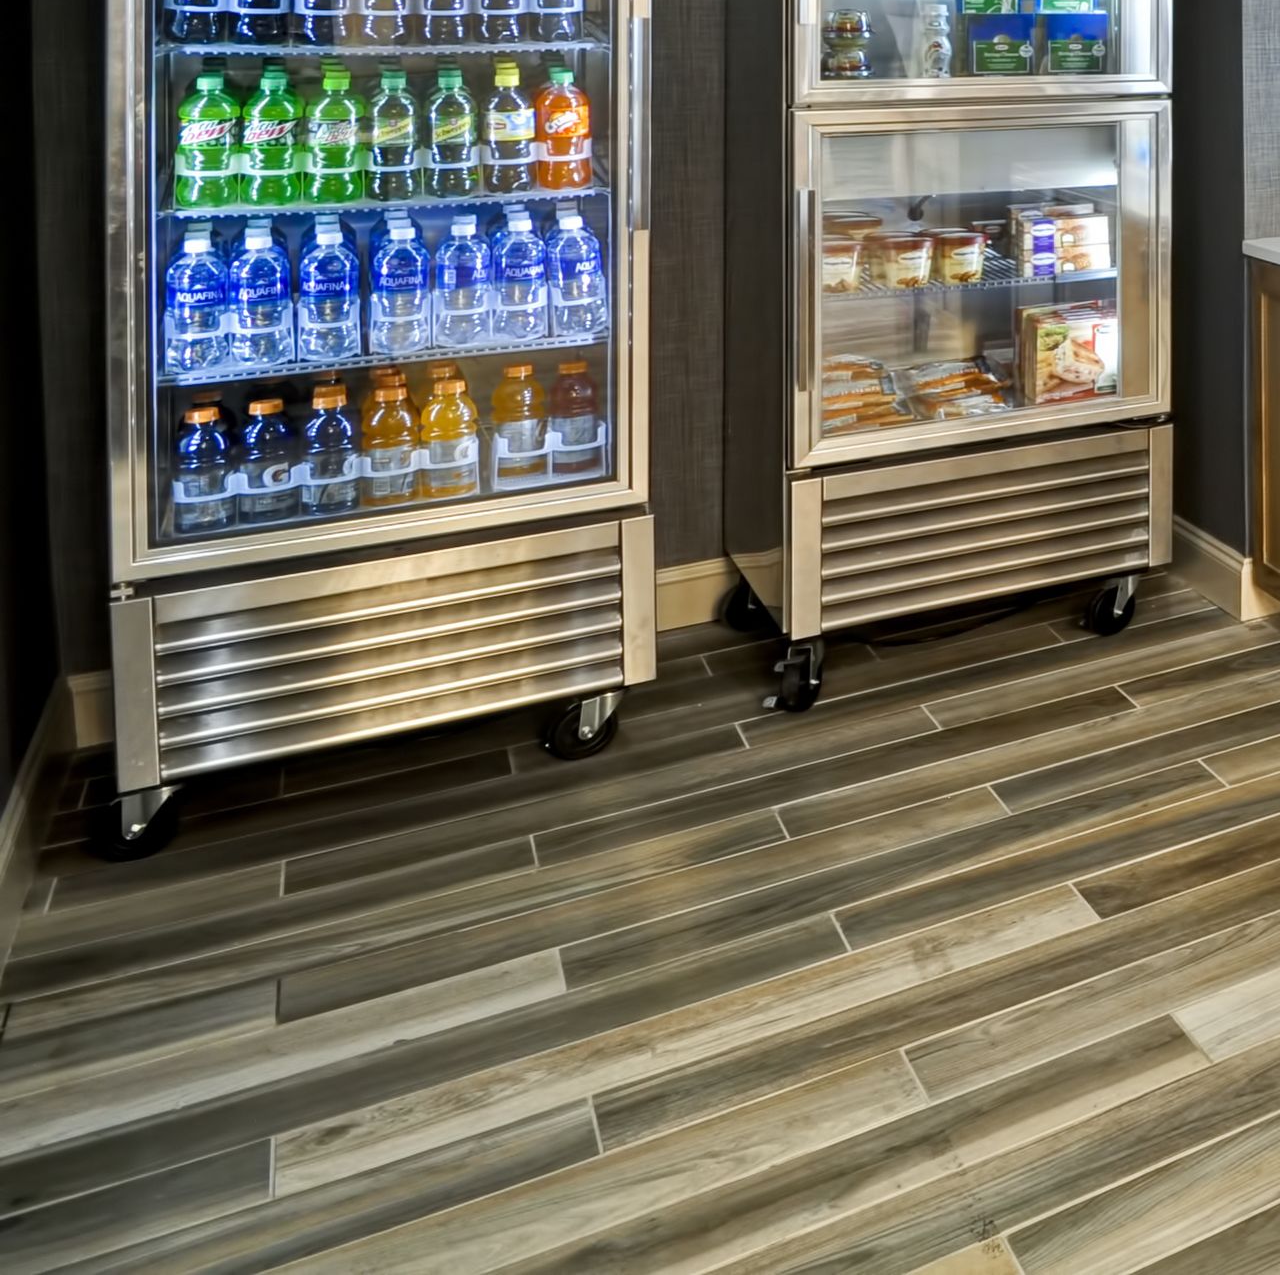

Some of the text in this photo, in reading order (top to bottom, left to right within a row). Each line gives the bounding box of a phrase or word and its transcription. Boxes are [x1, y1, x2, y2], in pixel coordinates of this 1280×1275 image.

[505, 264, 545, 277] AQUAFINA
[303, 281, 346, 292] AQUAFINA
[379, 276, 424, 287] AQUAFINA
[176, 288, 223, 303] AQUAFINA
[238, 282, 285, 300] AQUAFINA
